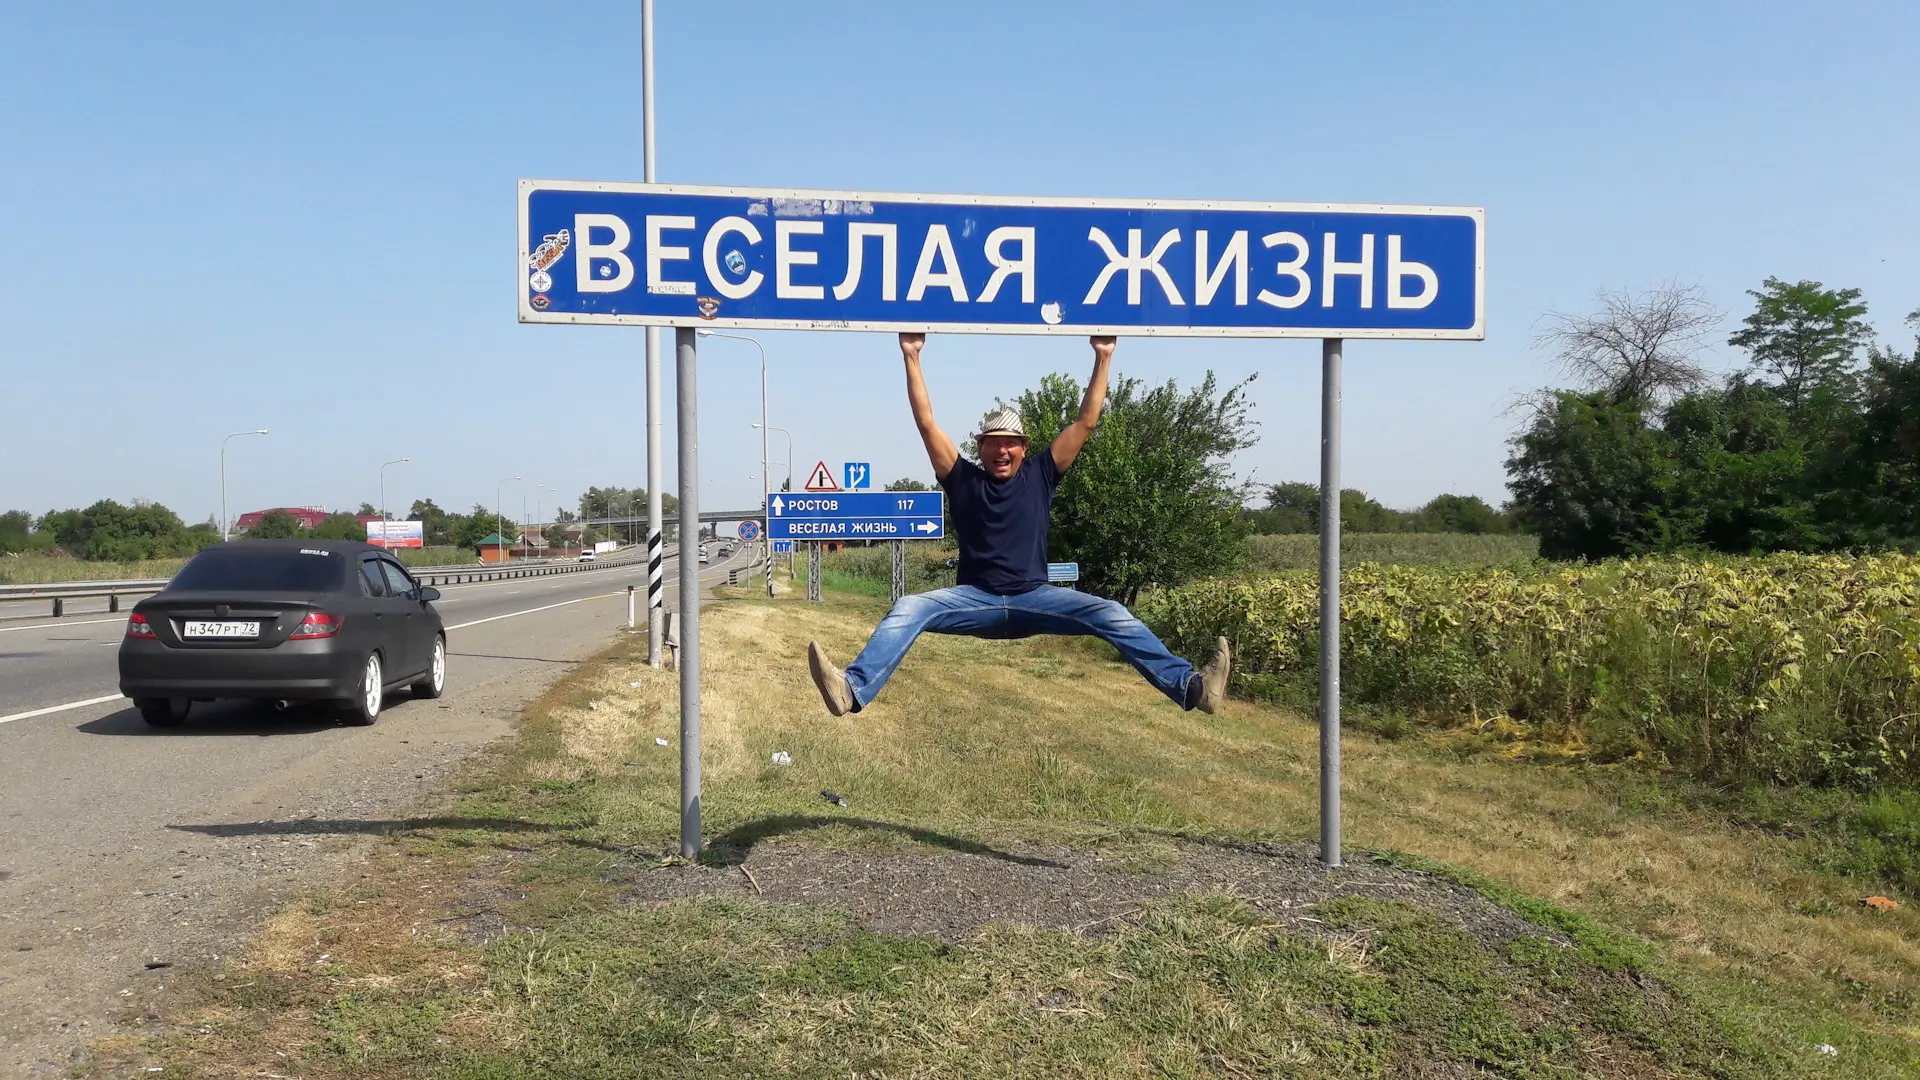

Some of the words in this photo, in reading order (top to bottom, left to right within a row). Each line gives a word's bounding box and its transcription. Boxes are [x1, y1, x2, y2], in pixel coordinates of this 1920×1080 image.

[574, 213, 1036, 304] ВЕСЕЛАЯ
[1082, 226, 1439, 309] ЖИЗНЬ
[788, 500, 839, 511] РОСТОВ
[897, 499, 915, 510] 117
[788, 522, 846, 534] ВЕСЕЛАЯ
[851, 522, 897, 533] ЖИЗНЬ
[243, 623, 255, 632] 72
